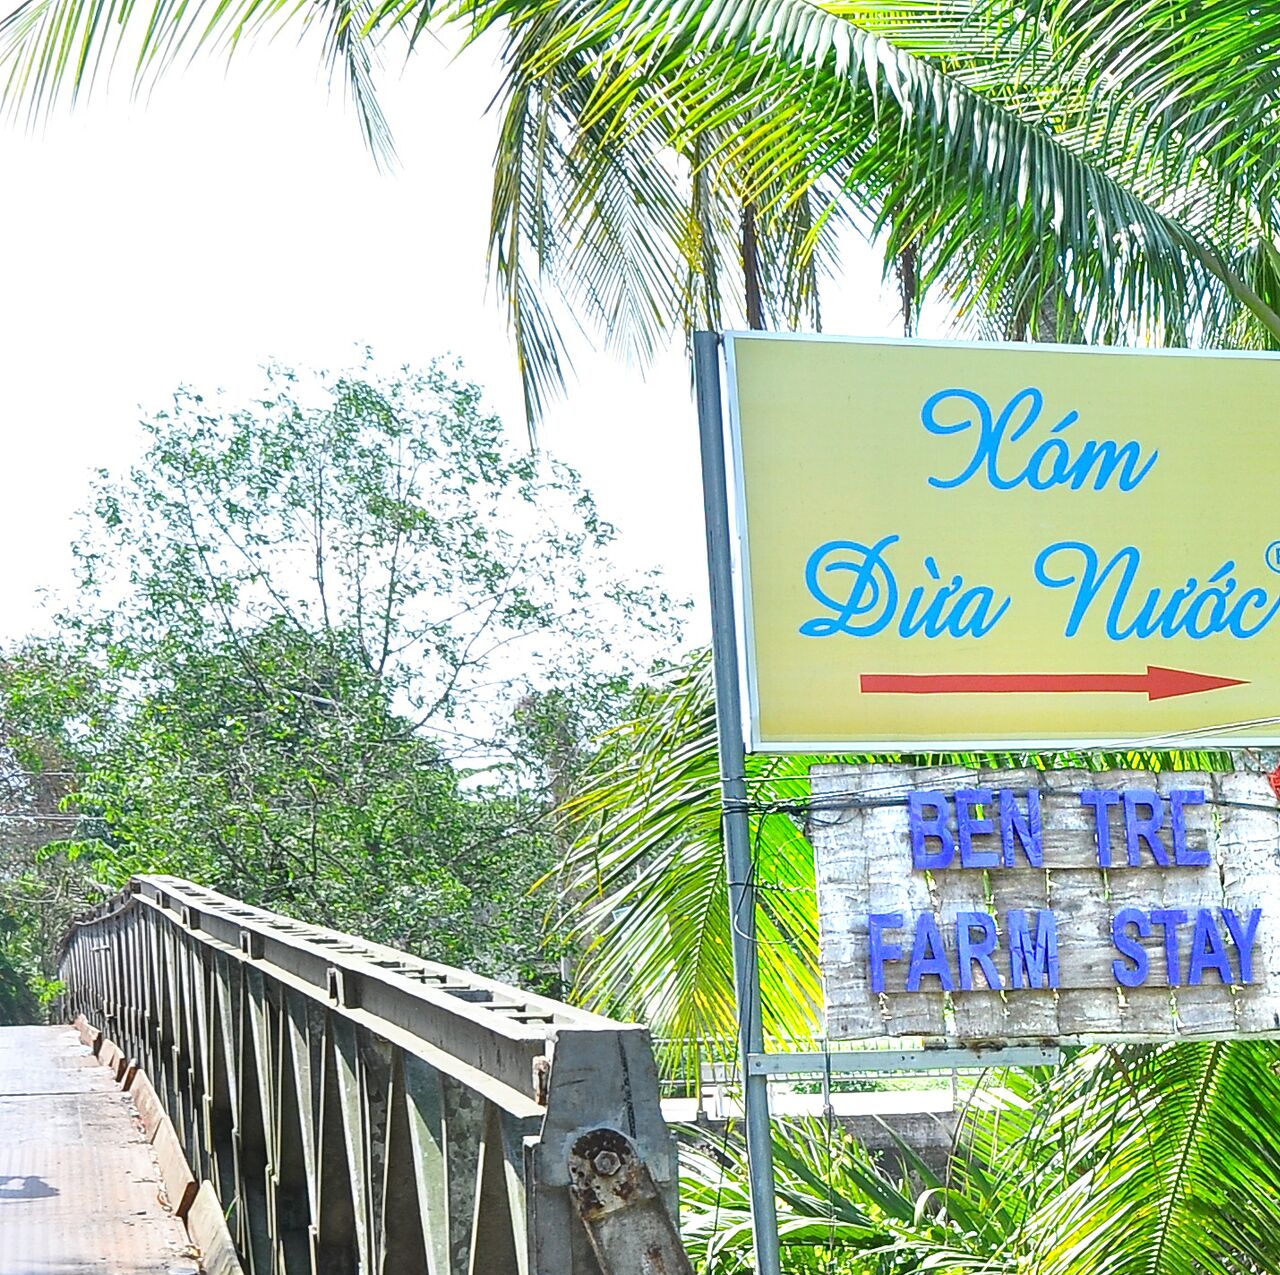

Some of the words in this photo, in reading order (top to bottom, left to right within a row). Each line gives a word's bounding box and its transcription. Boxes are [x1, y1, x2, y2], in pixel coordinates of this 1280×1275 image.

[921, 387, 1158, 491] Xóm
[799, 534, 1011, 639] Dừa
[908, 788, 1043, 869] BEN
[866, 910, 1060, 993] FARM
[1110, 908, 1263, 987] STAY
